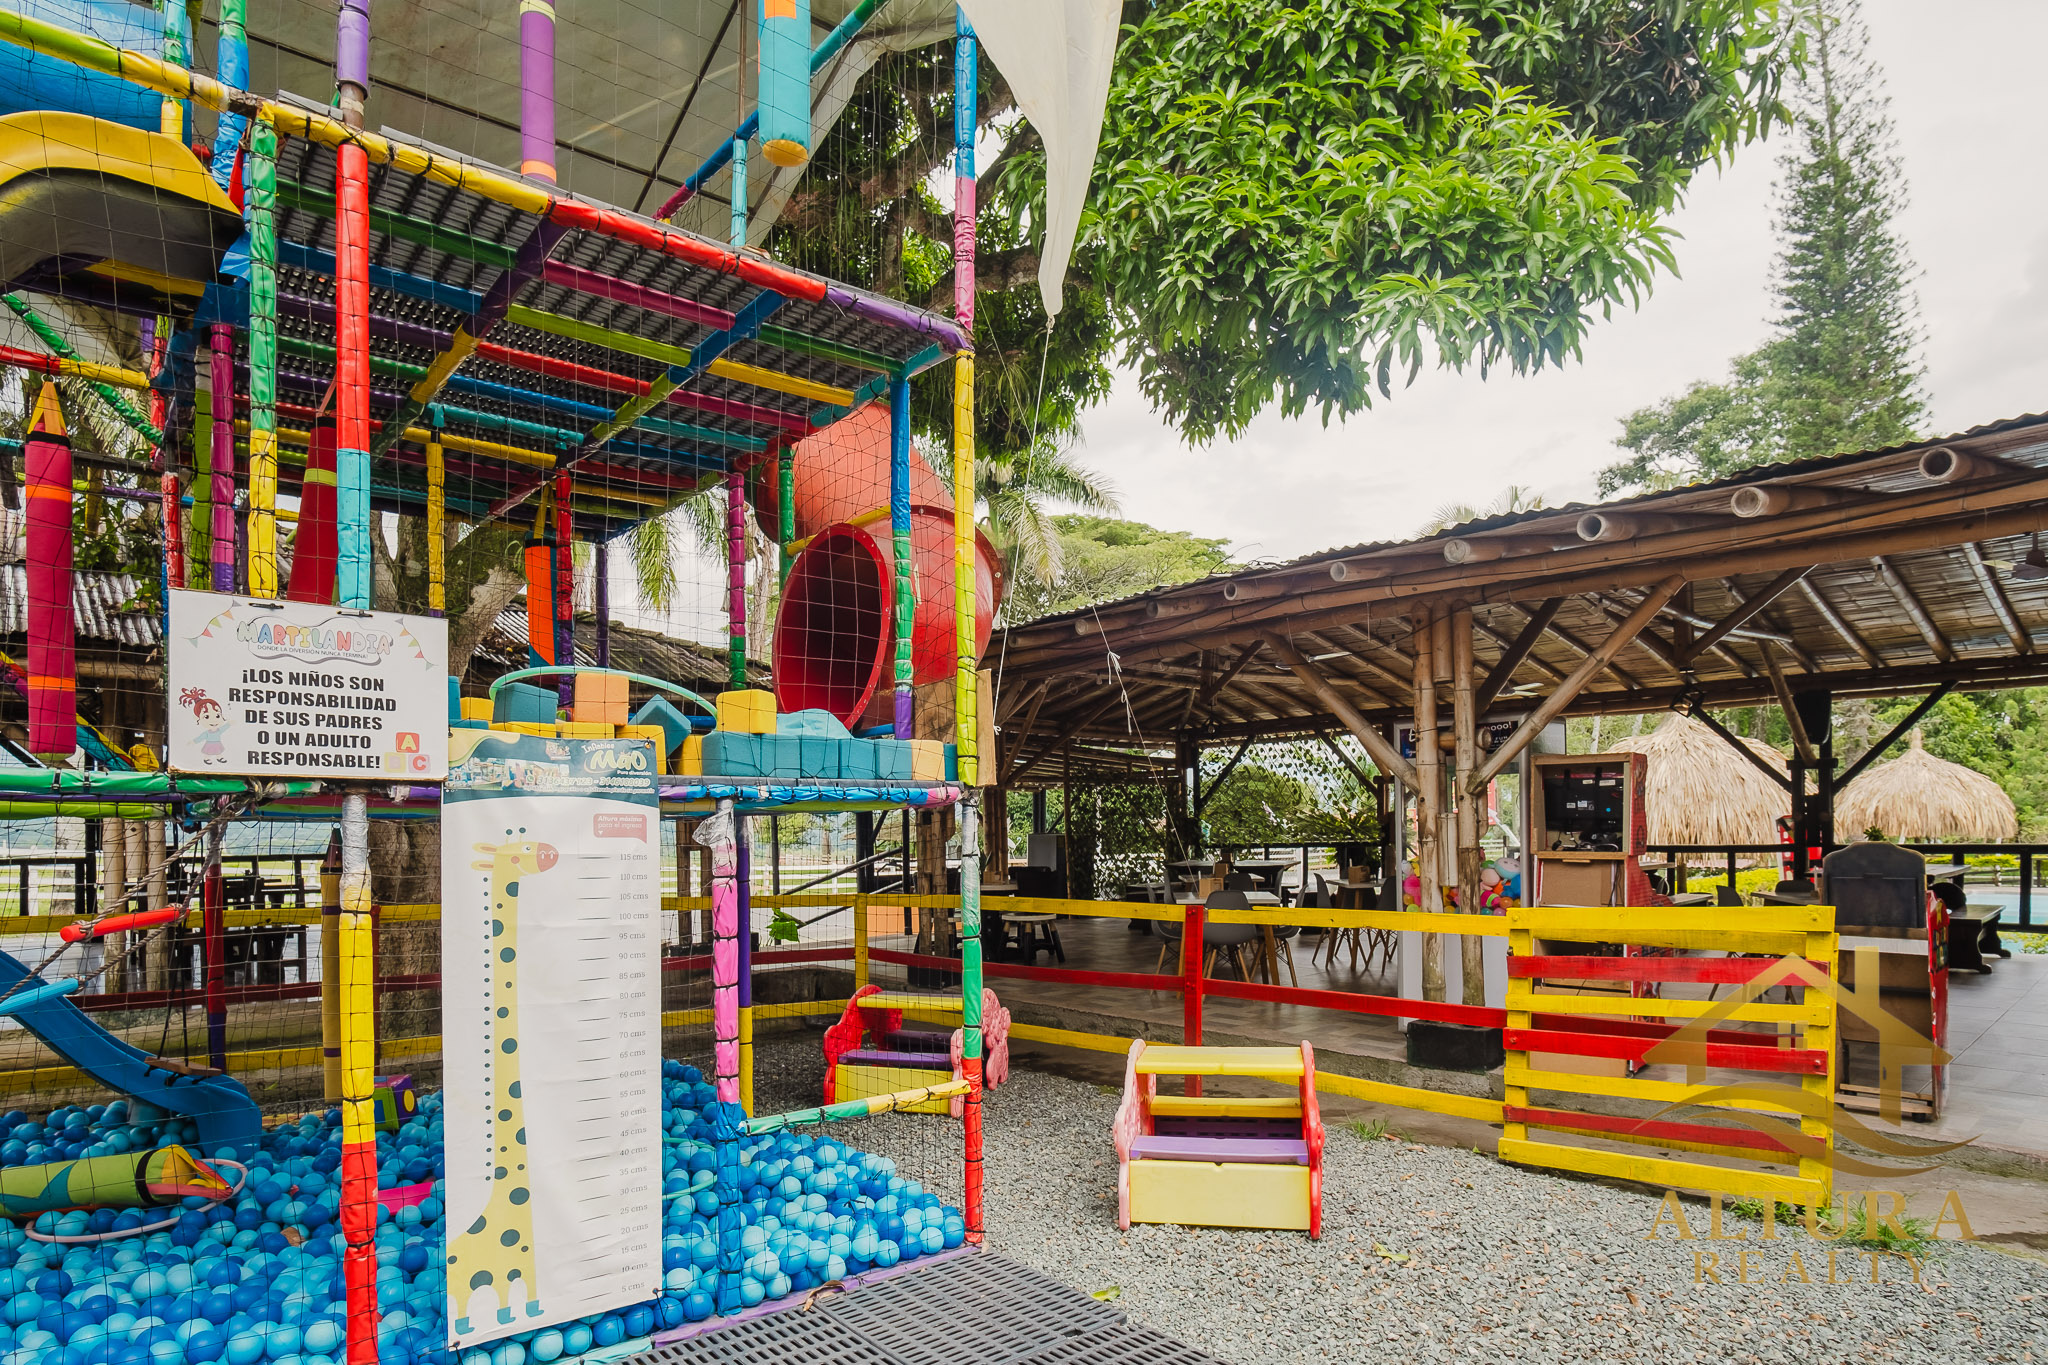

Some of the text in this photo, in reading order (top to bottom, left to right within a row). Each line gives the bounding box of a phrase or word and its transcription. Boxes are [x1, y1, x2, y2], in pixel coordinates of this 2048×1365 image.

[237, 621, 391, 655] MARTILANDIA
[257, 644, 279, 652] DONDE
[242, 669, 384, 692] ¡LOS NIÑOS SON
[229, 688, 396, 711] RESPONSABILIDAD
[245, 709, 382, 730] DE SUS PADRES
[257, 730, 371, 749] O UN ADULTO
[400, 734, 417, 751] A
[248, 750, 380, 768] RESPONSABLE!
[412, 755, 427, 771] C
[619, 912, 631, 920] 100
[619, 932, 645, 940] 95 cms
[619, 951, 646, 960] 90 cms
[619, 971, 646, 980] 85 cms
[620, 992, 629, 1000] 80
[619, 1010, 646, 1019] 75 cms
[619, 1030, 646, 1039] 70 cms
[620, 1049, 646, 1059] 65 cms
[619, 1069, 646, 1078] 60 cms
[620, 1088, 646, 1098] 55 cms
[620, 1107, 647, 1118] 50 cms
[620, 1127, 647, 1137] 45 cms
[620, 1146, 647, 1157] 40 cms
[620, 1165, 647, 1176] 35 cms
[620, 1185, 647, 1196] 30 cms
[620, 1204, 648, 1215] 25 cms
[621, 1223, 648, 1235] 20 cms
[621, 1243, 647, 1254] 15 cms
[621, 1262, 648, 1273] 10 cms
[621, 1281, 645, 1293] 5 cms
